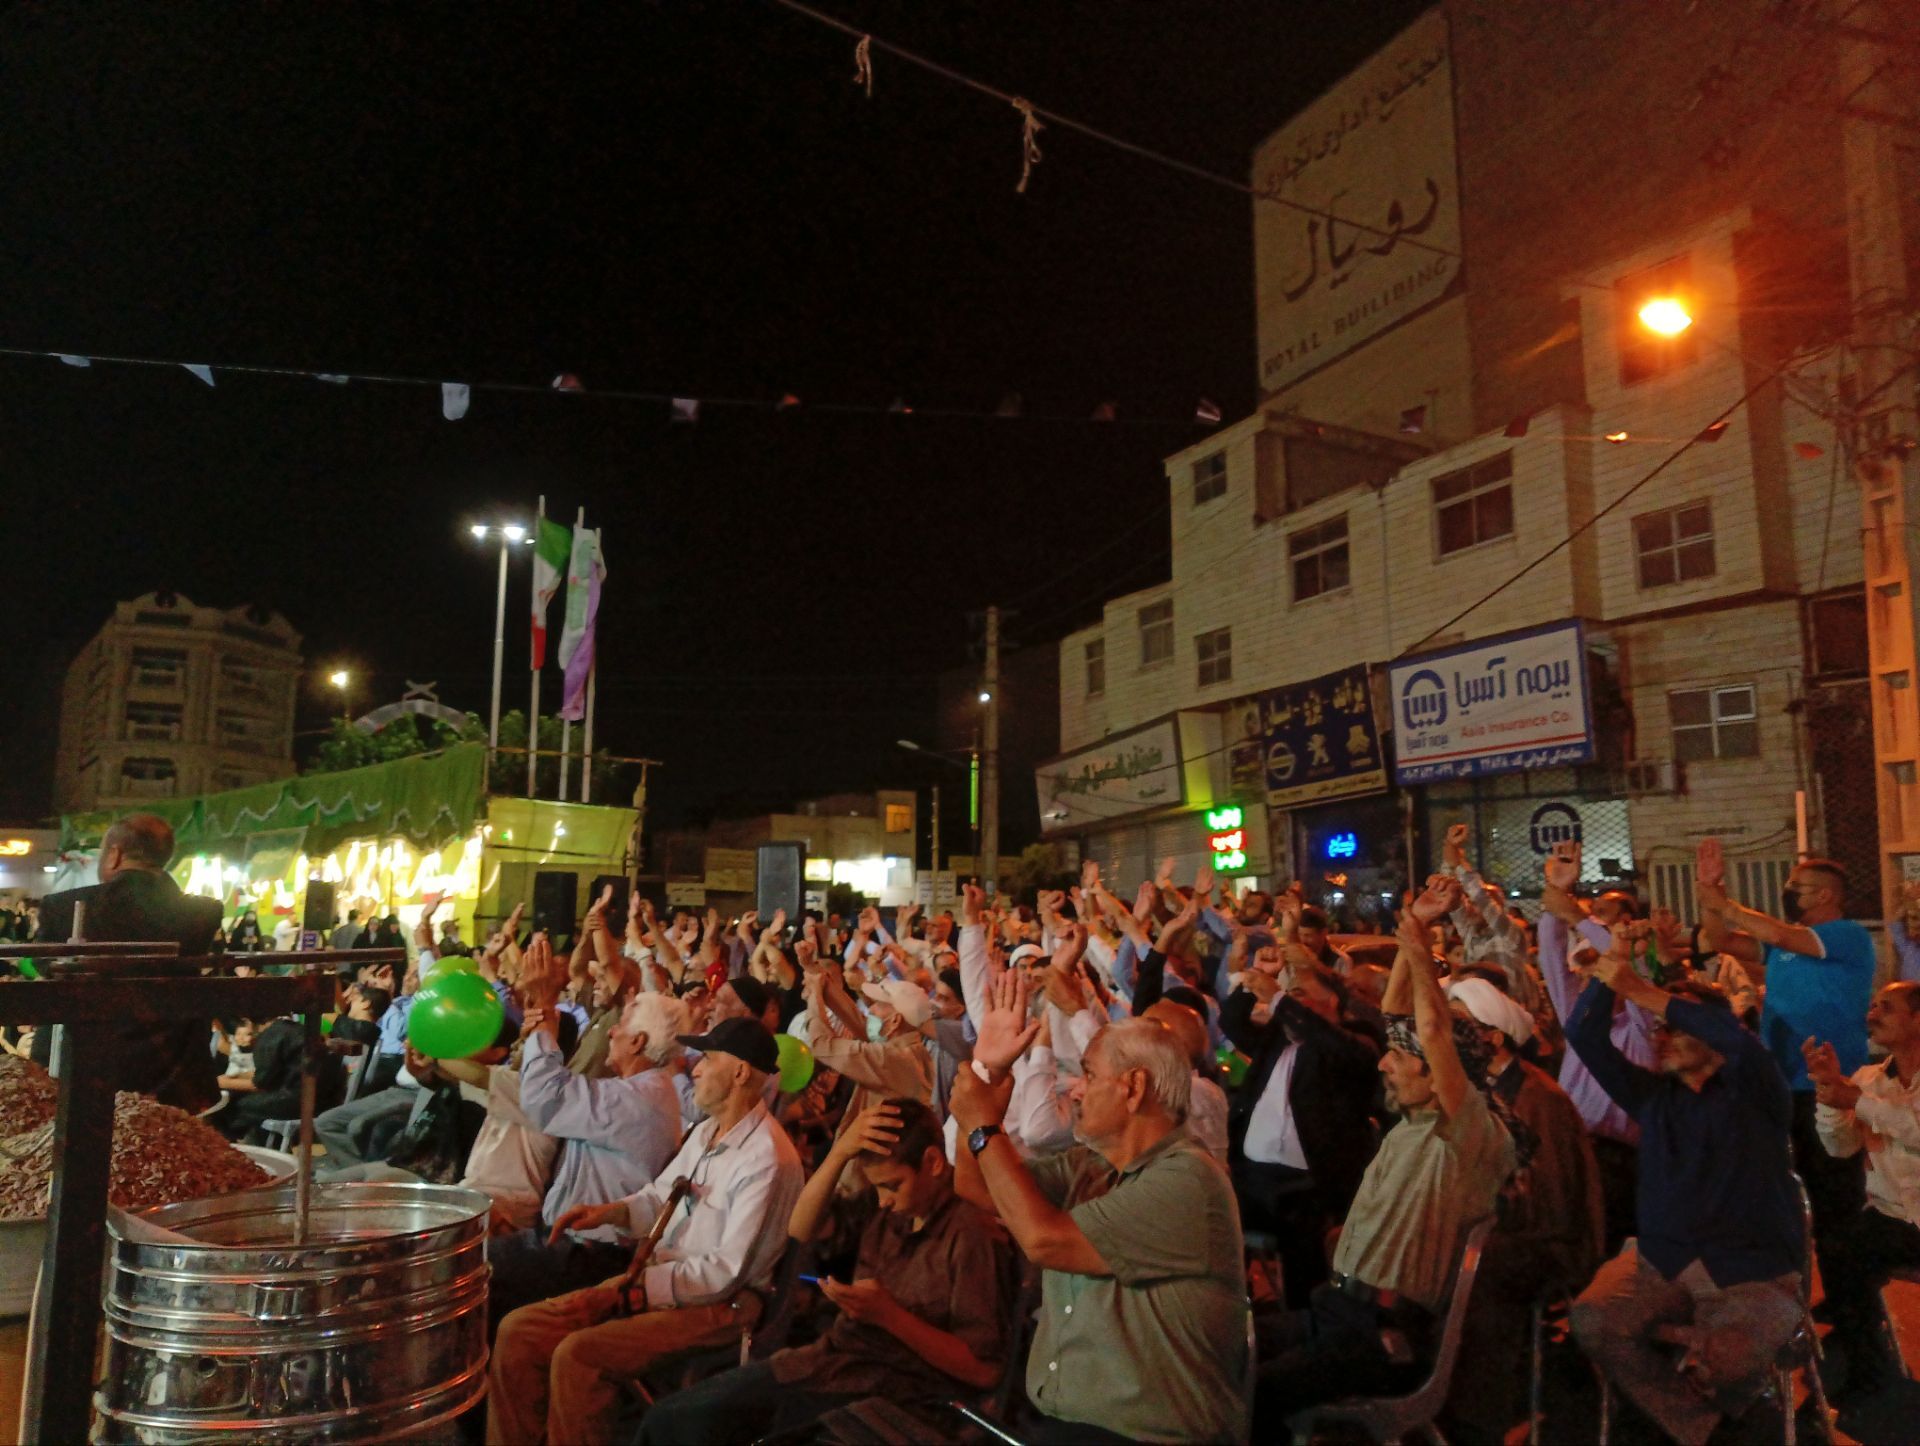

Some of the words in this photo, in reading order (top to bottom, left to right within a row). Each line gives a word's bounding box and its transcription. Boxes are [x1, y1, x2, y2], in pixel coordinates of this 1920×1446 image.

[1283, 178, 1441, 302] رویال
[1265, 330, 1320, 378] ROYAL
[1455, 655, 1507, 716] آسیا
[1516, 659, 1571, 699] بیمه
[1461, 724, 1486, 740] Asia
[1488, 716, 1548, 735] Insurance
